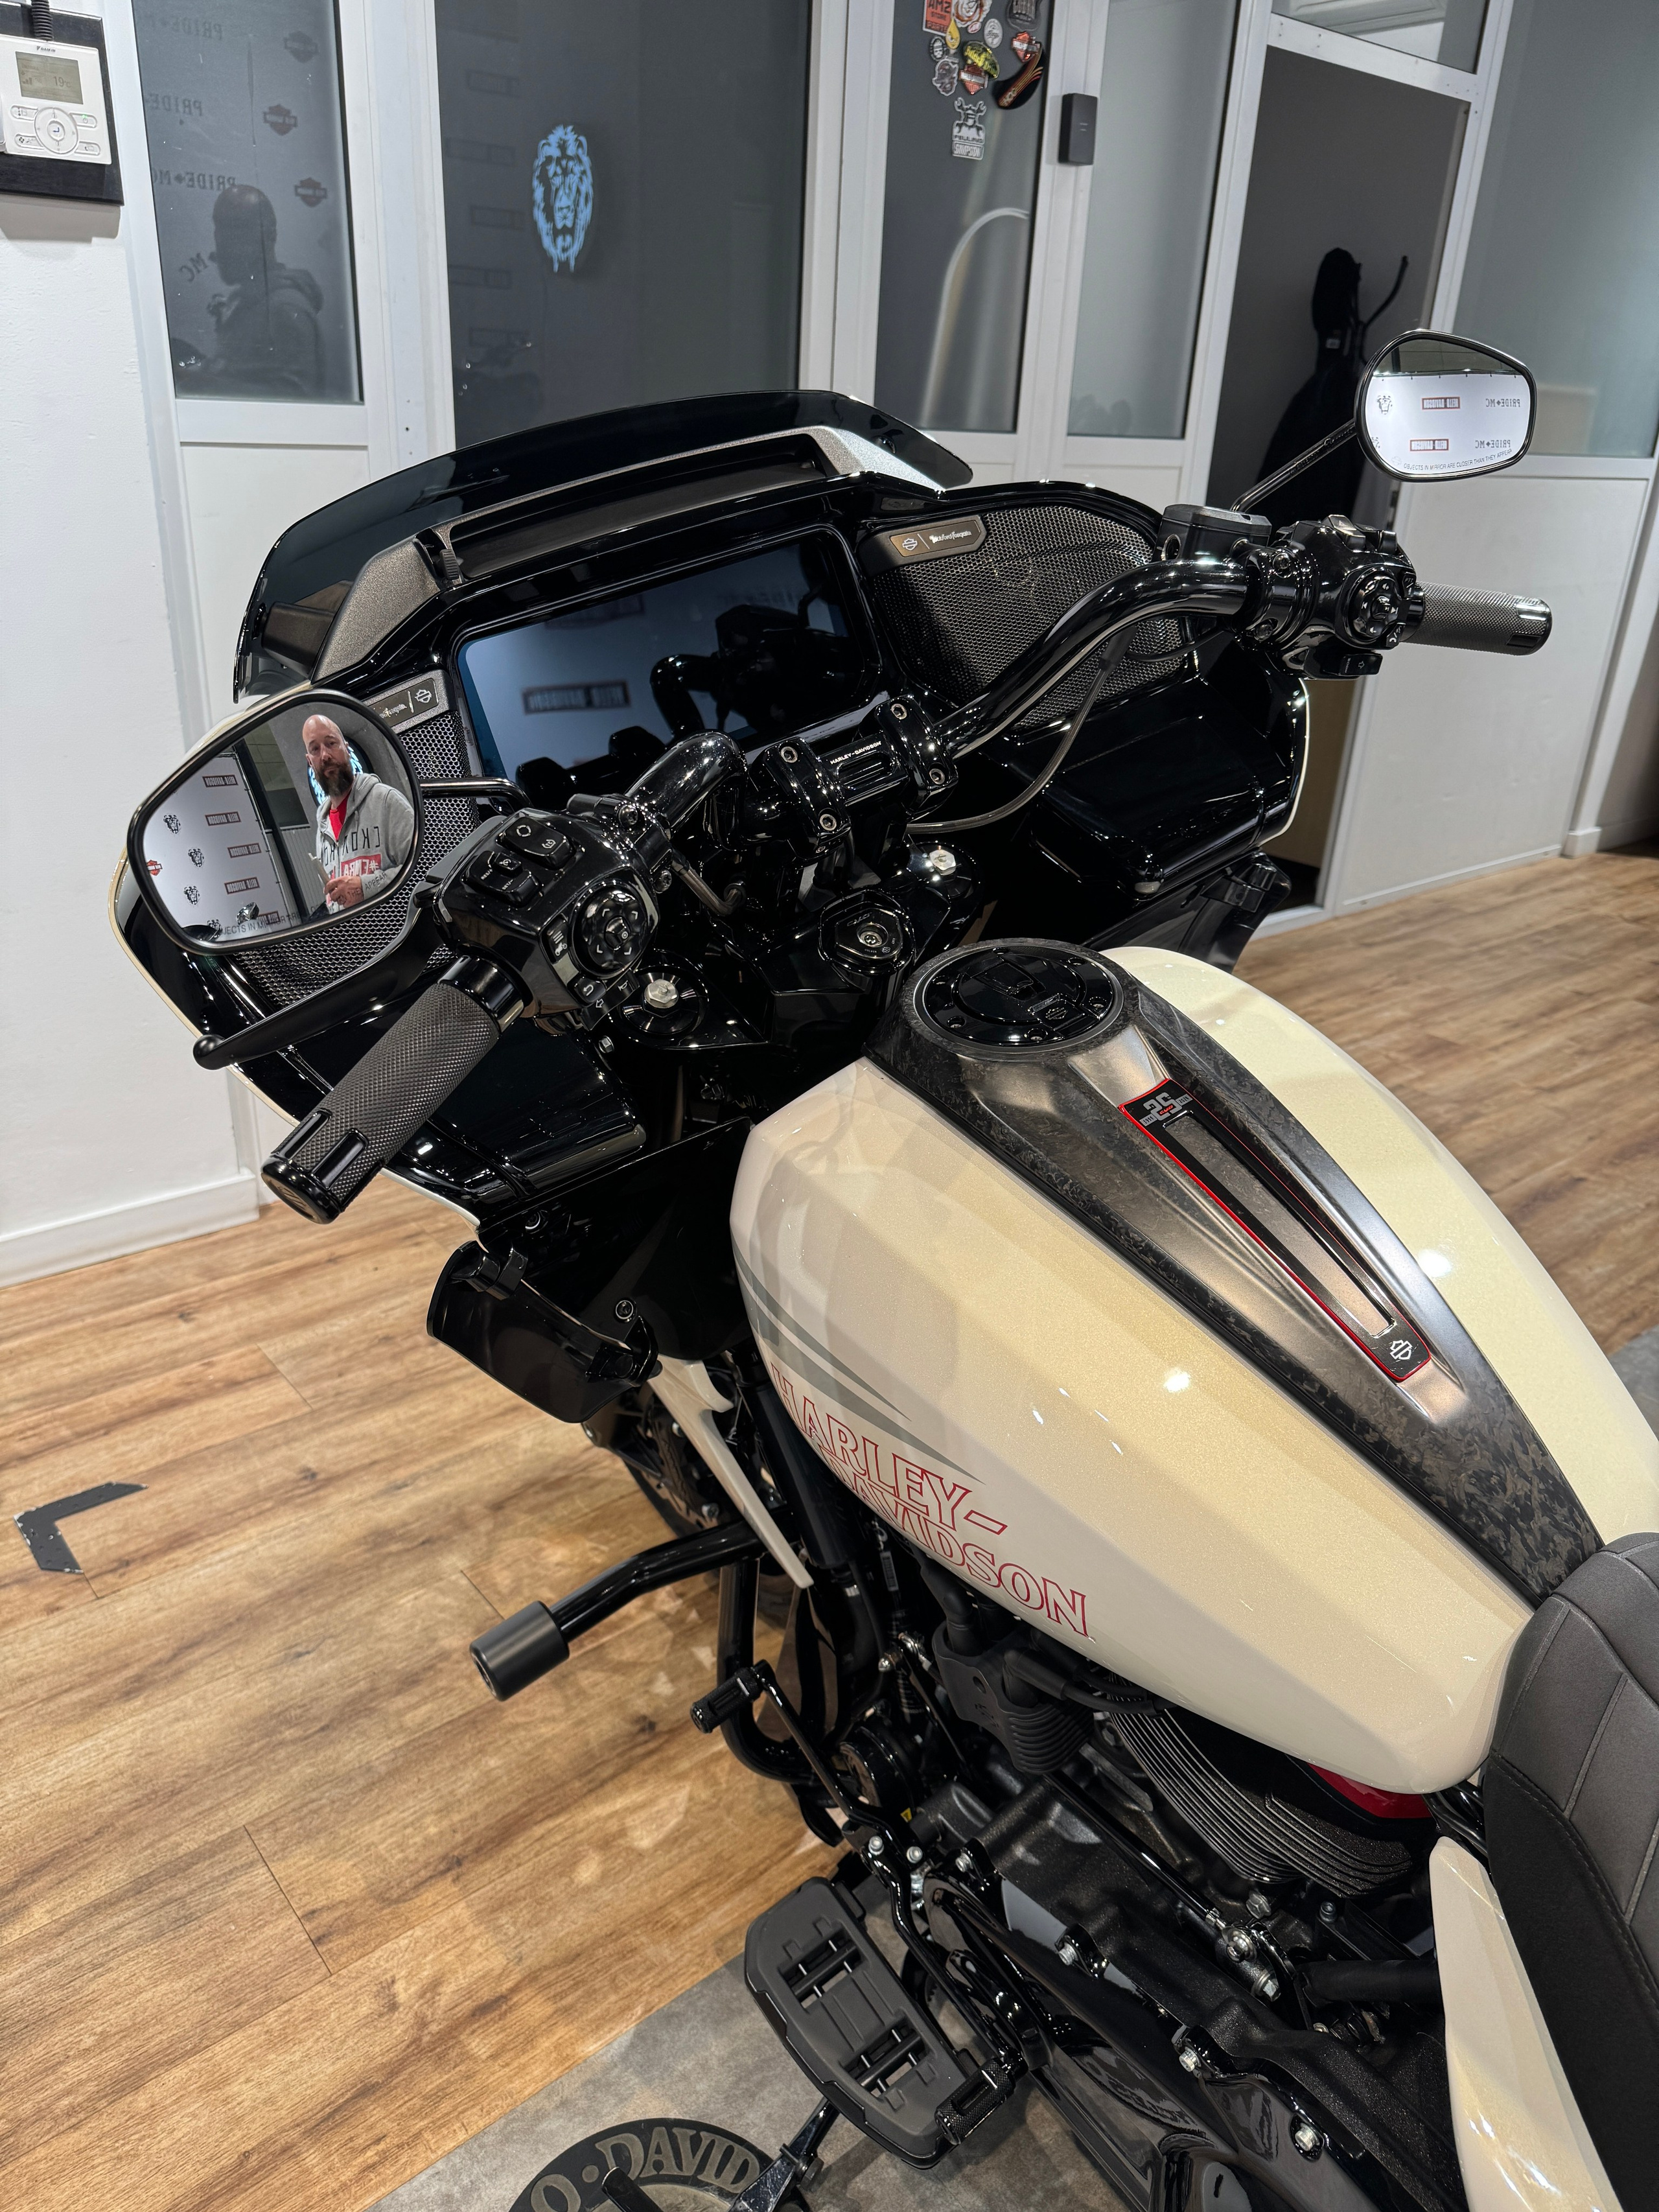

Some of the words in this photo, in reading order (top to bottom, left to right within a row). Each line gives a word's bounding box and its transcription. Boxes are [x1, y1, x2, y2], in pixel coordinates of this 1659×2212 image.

[1496, 448, 1513, 458] APPEAR
[830, 741, 882, 765] HARLEY-DAVIDSON
[365, 872, 388, 891] APPEAR
[1143, 1092, 1183, 1121] 25
[771, 1362, 1008, 1535] HARLEY-
[817, 1443, 1089, 1638] DAVIDSON
